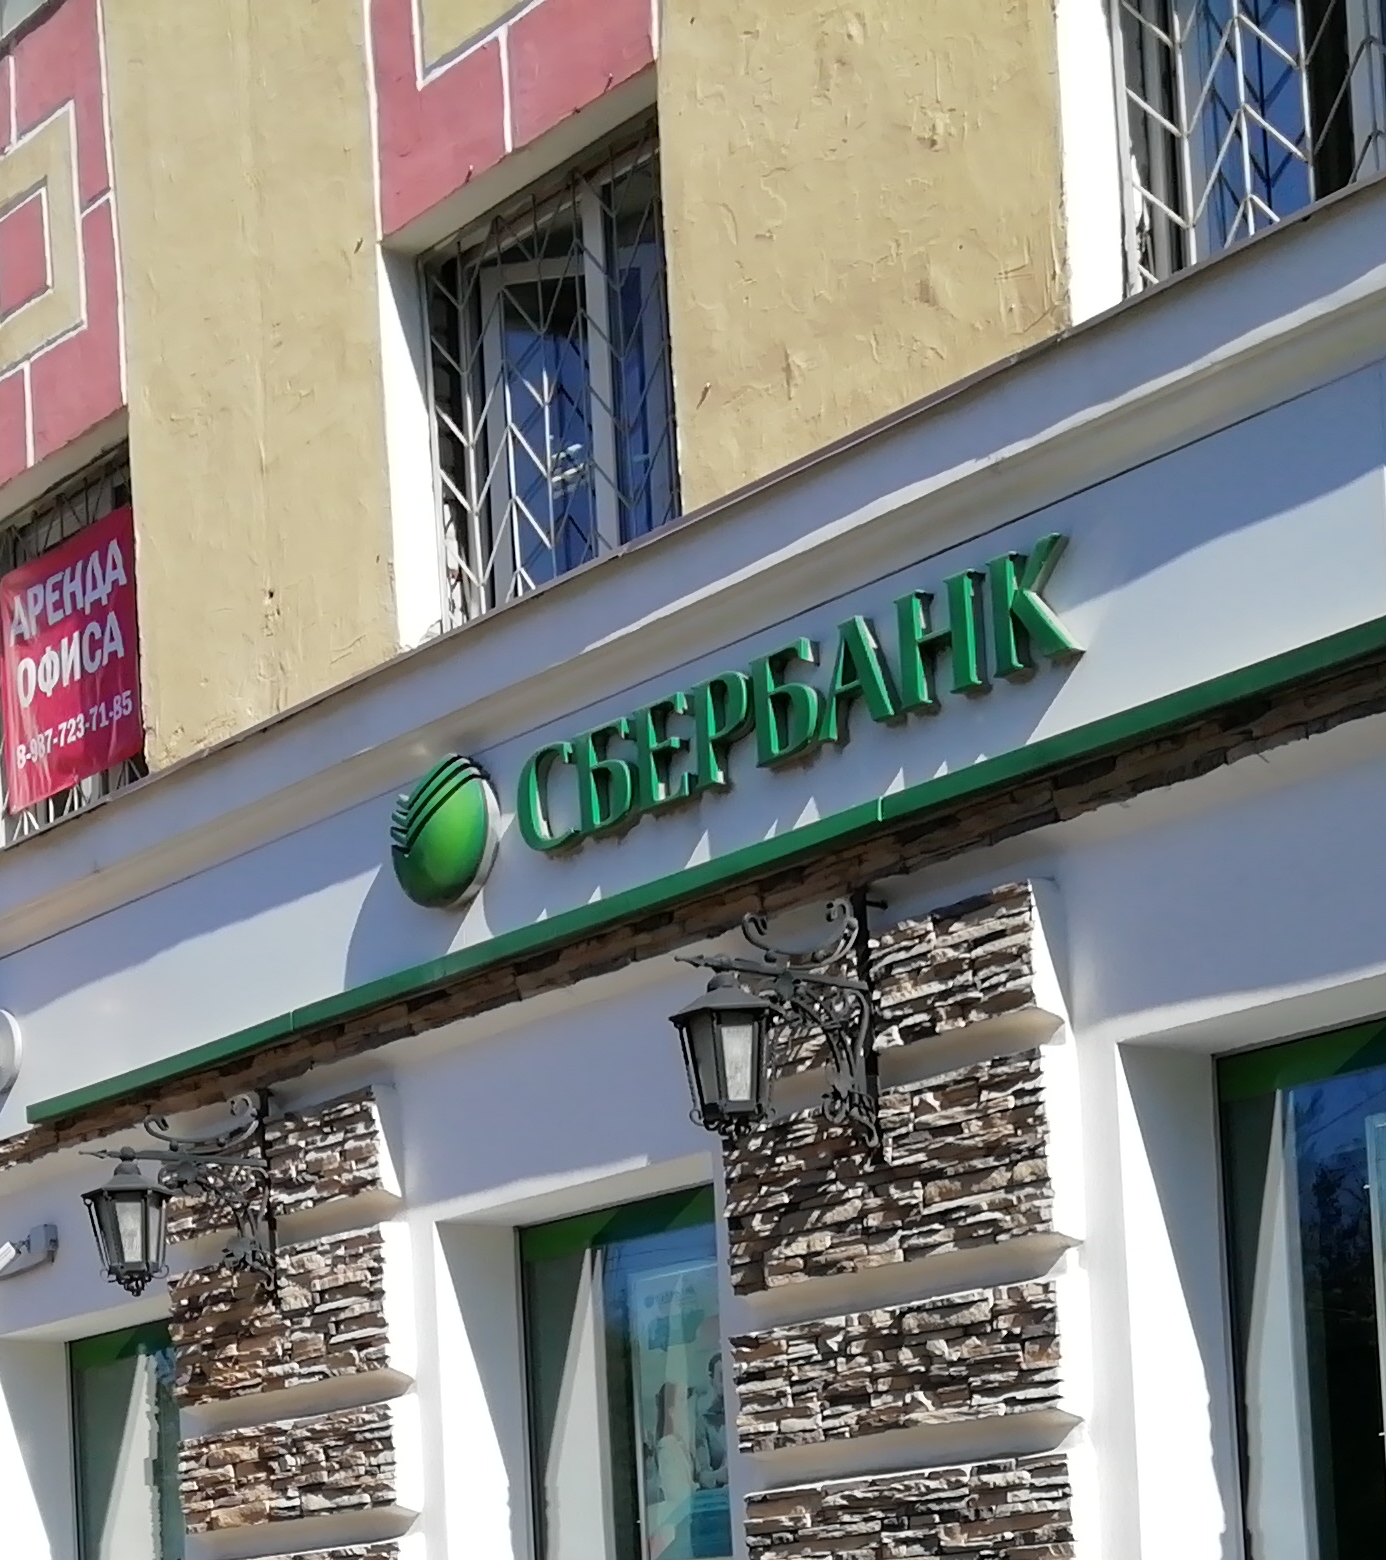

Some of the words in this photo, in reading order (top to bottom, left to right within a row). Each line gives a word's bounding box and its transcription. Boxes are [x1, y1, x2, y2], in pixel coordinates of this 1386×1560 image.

[10, 539, 127, 647] АРЕНДА
[16, 611, 125, 709] ОФИСА
[516, 532, 1085, 852] СБЕРБАНК
[16, 690, 133, 769] 8-987-723-71-85
